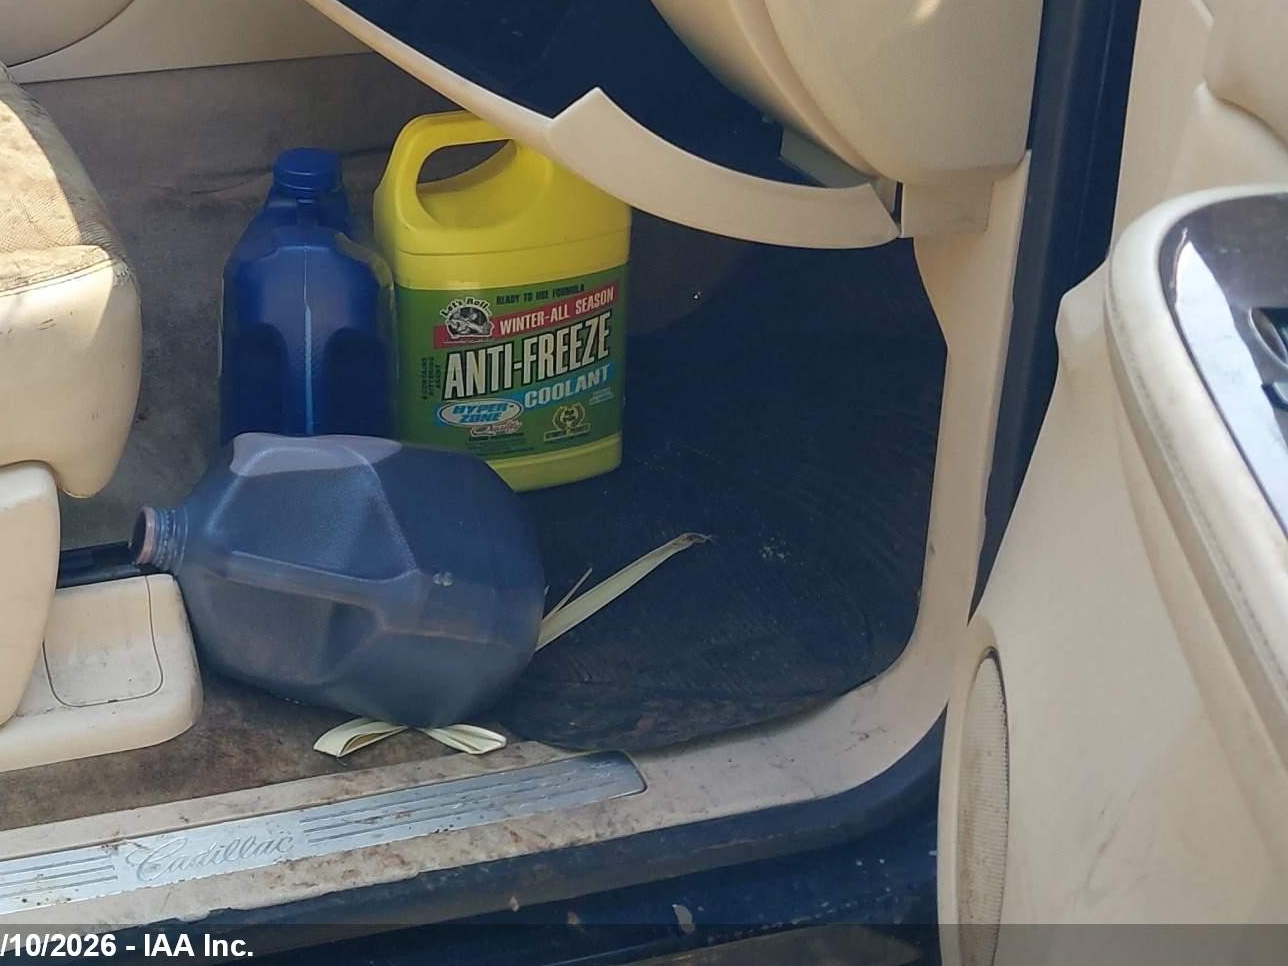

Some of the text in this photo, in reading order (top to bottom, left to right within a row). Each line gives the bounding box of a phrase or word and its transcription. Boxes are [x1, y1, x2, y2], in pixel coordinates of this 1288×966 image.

[499, 286, 614, 336] WINTER-ALL SEASON
[443, 311, 612, 400] ANTI-FREEZE
[524, 364, 611, 409] COOLANT
[124, 835, 295, 883] Cadillac
